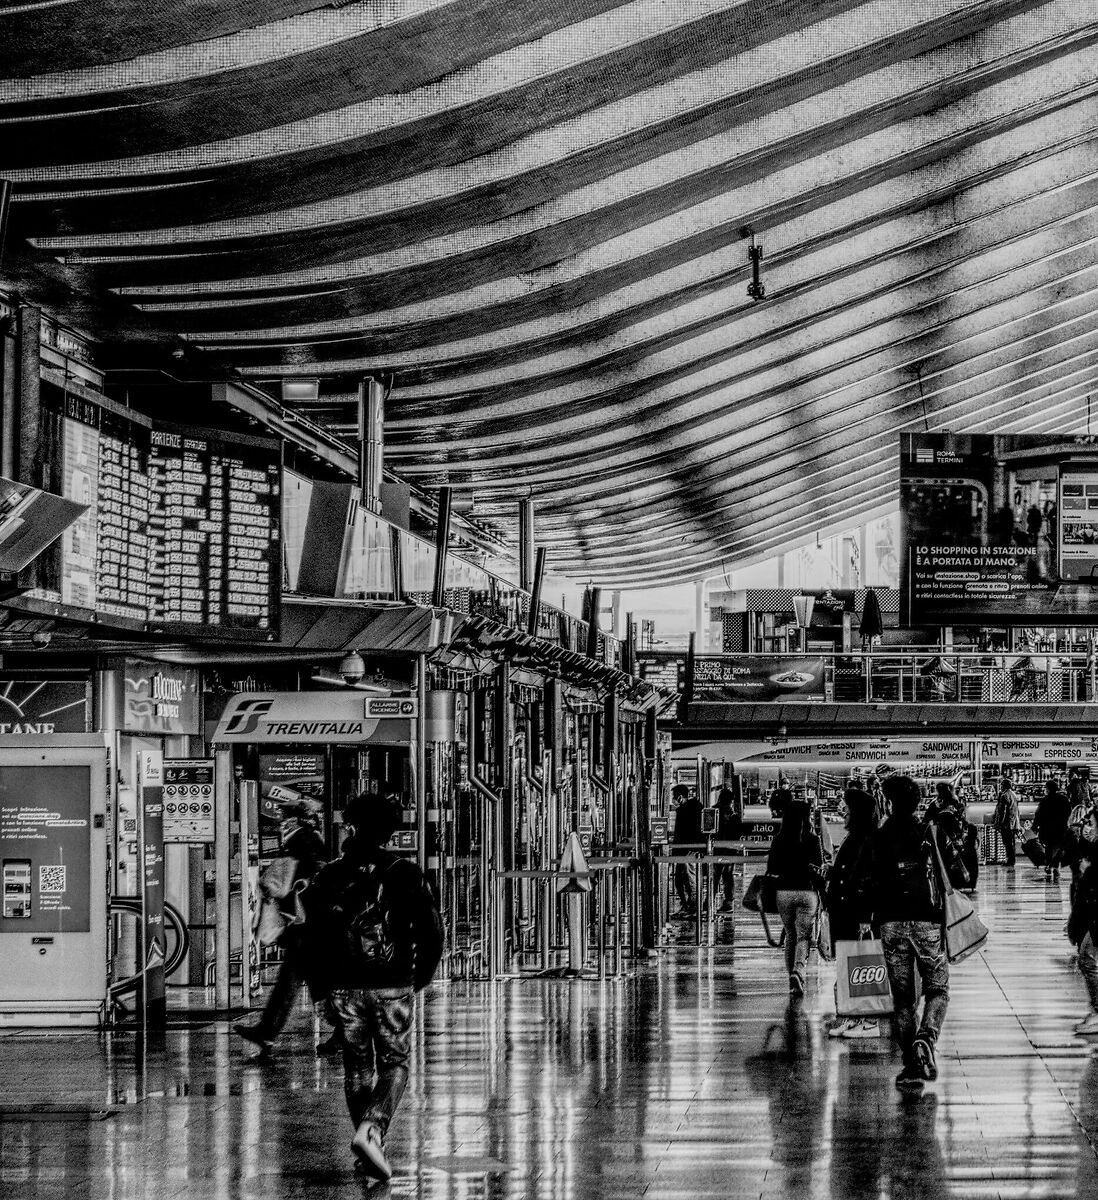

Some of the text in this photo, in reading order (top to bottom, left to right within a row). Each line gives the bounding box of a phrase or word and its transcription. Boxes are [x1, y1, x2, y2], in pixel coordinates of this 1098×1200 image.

[151, 431, 181, 448] PARTENZE
[916, 546, 1037, 555] LO SHOPPING IN STAZIONE
[916, 555, 921, 565] È
[933, 558, 972, 566] PORTATA
[985, 558, 1018, 566] MANO.
[266, 723, 363, 735] TRENITALIA
[922, 742, 963, 752] SANDWICH
[981, 741, 999, 756] AR
[1002, 741, 1040, 749] ESPRESSO
[845, 751, 886, 760] SANDWICH
[1044, 749, 1082, 758] ESPRESSO
[851, 966, 886, 984] LEGO
